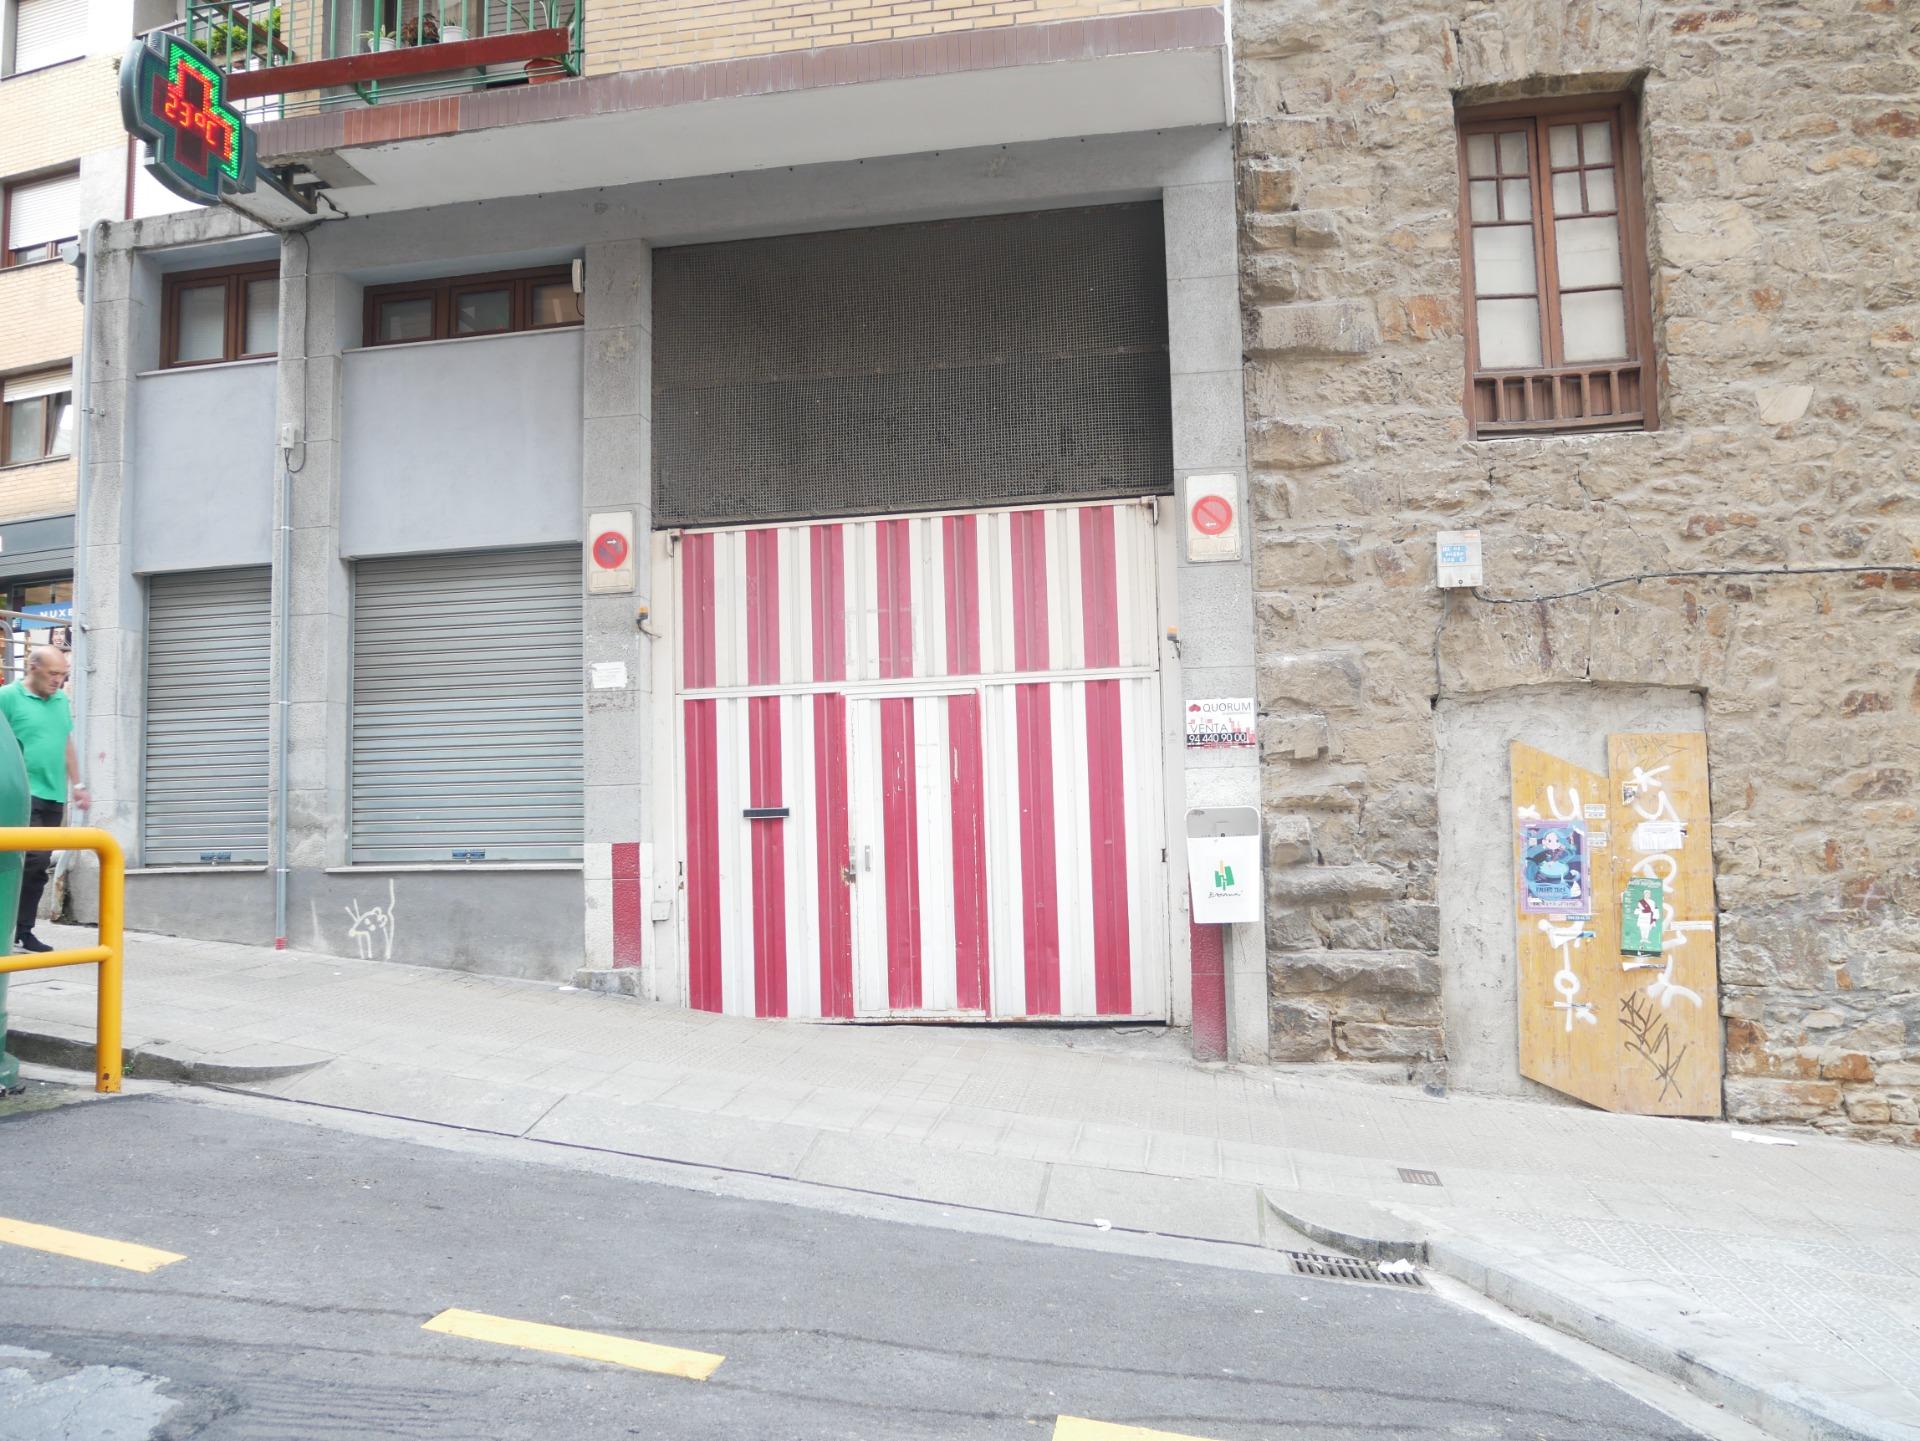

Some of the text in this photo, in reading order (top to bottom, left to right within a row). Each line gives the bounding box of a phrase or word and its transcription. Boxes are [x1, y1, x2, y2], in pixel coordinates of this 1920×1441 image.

[1203, 702, 1251, 712] QUORUM
[1190, 723, 1229, 733] VENTA
[1188, 732, 1246, 743] 94 440 90 00
